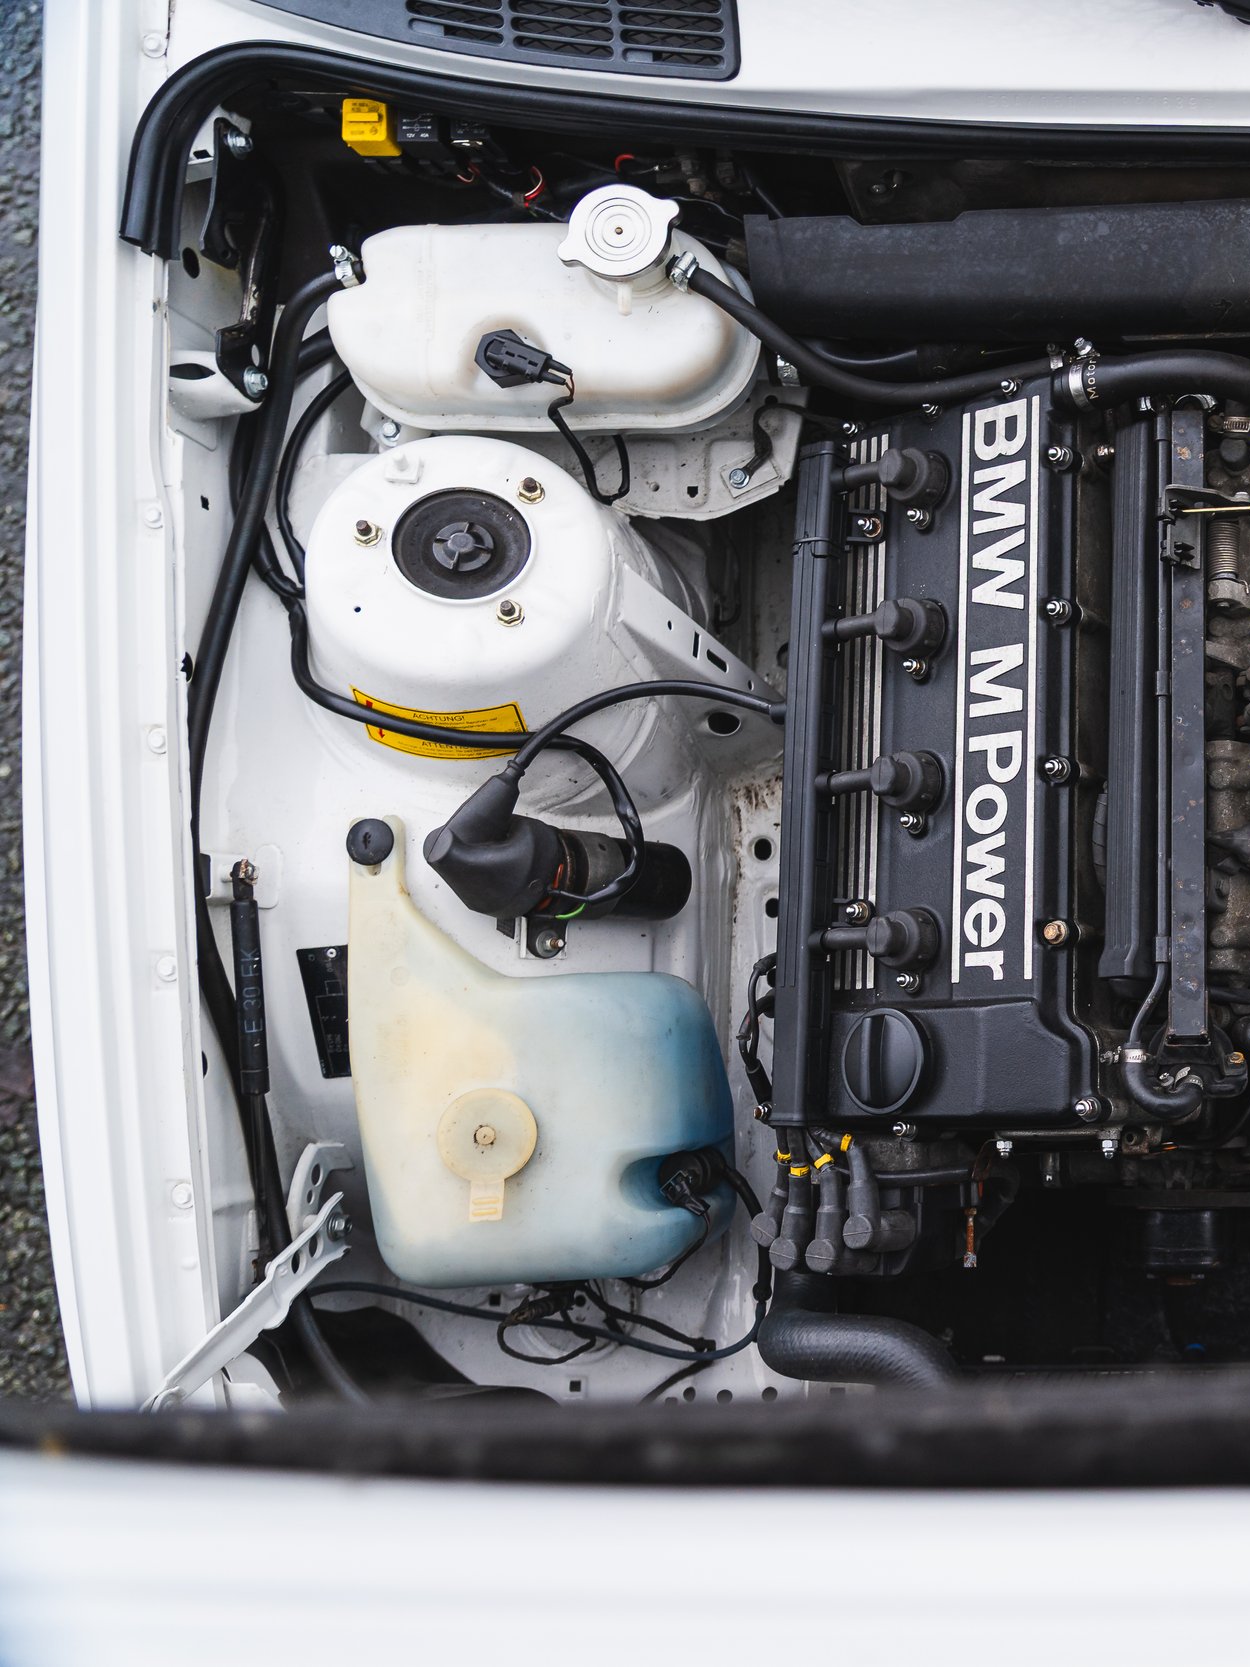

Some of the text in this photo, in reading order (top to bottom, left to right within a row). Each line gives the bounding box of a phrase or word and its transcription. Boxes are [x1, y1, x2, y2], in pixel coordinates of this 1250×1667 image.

[1086, 360, 1100, 400] Motor
[972, 398, 1027, 609] BMW
[412, 712, 465, 722] ACHTUNG!
[240, 948, 262, 1033] E 30 FK
